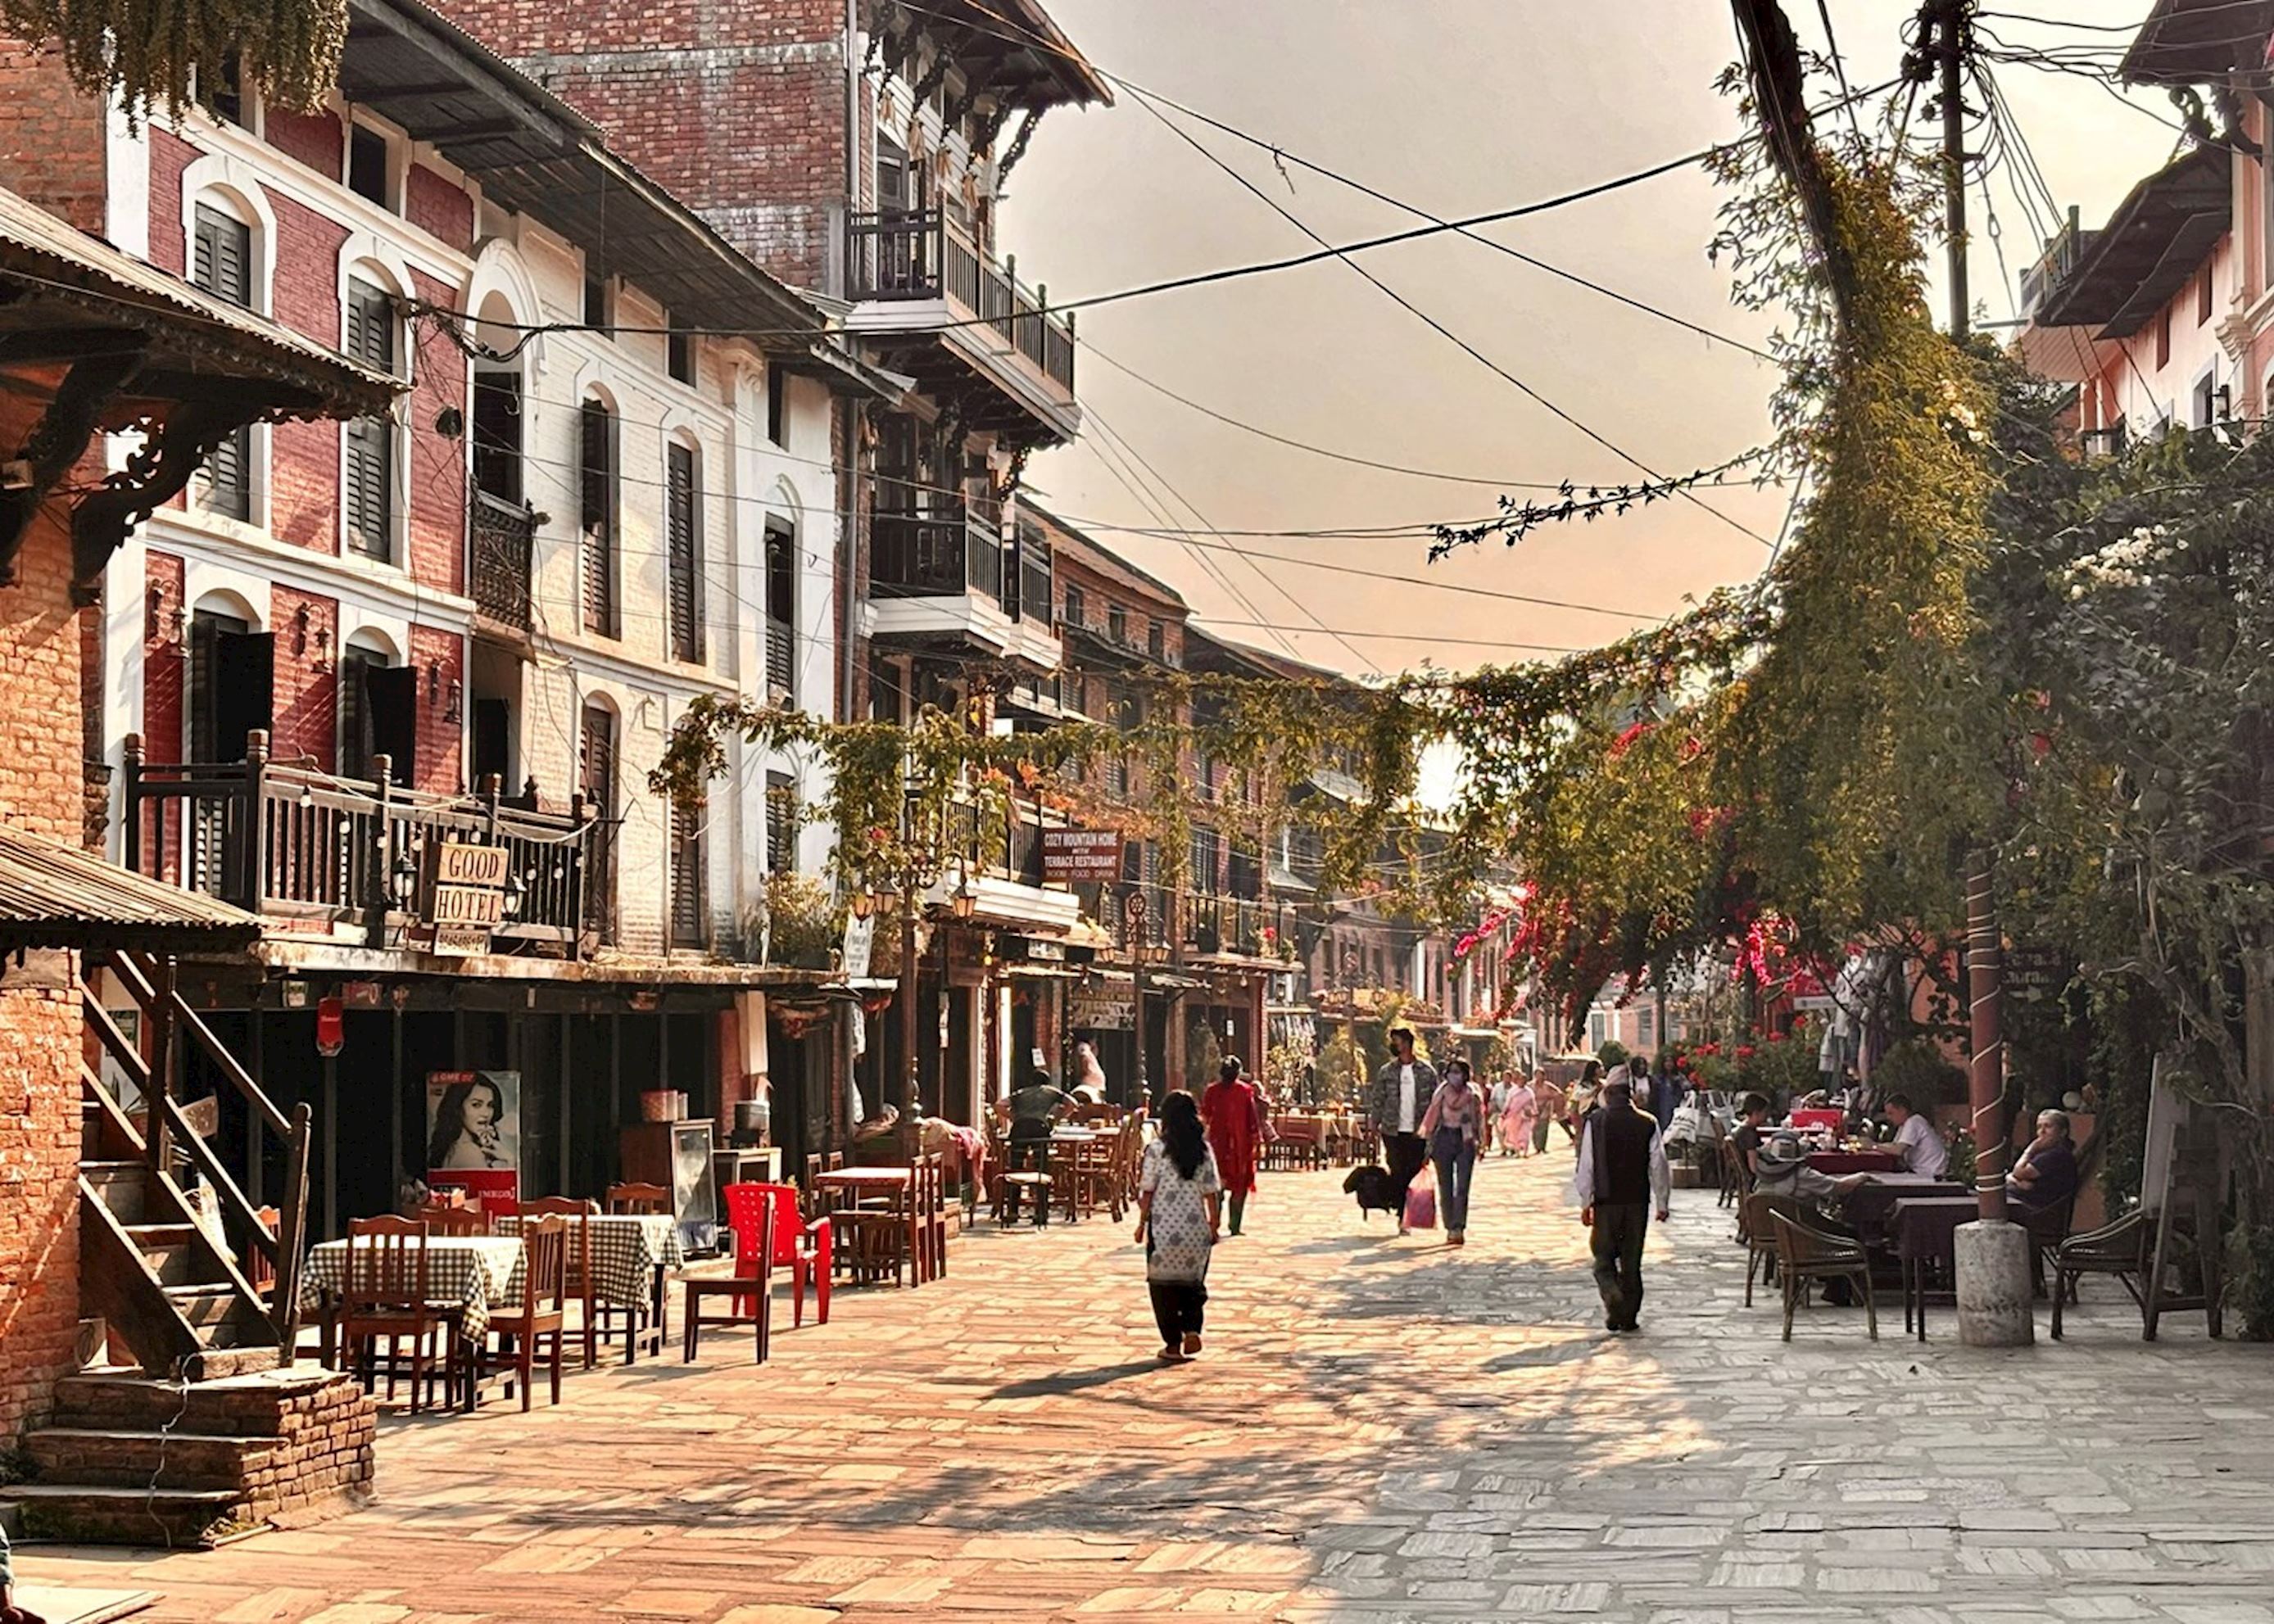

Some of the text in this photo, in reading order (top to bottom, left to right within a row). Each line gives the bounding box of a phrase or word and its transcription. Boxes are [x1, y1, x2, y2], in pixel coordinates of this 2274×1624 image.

[1044, 832, 1117, 847] COZY MOUNTAIN HOME
[449, 848, 499, 880] GOOD
[1044, 856, 1117, 868] TERRACE RESTAURANT
[1071, 870, 1090, 878] FOOD
[437, 890, 498, 923] HOTEL
